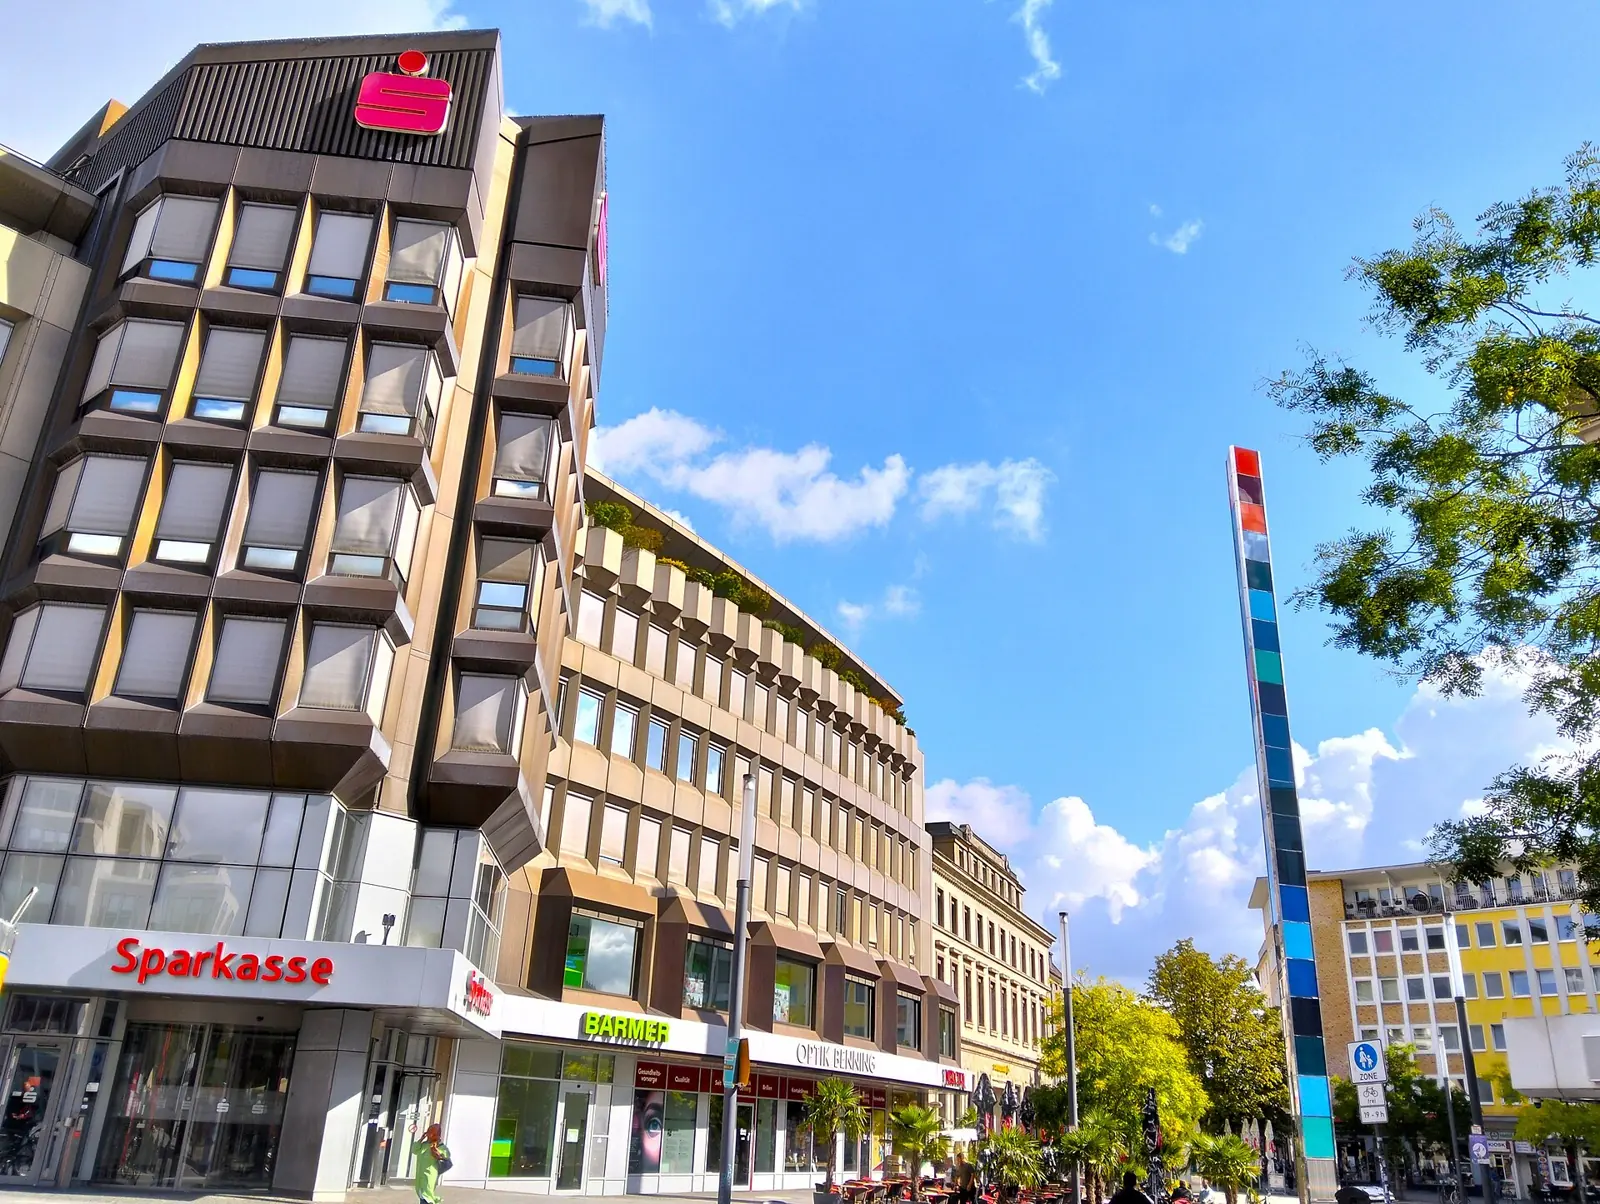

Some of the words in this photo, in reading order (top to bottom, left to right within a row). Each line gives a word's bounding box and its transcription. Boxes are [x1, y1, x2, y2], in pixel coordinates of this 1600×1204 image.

[111, 937, 334, 985] Sparkasse
[584, 1012, 670, 1043] BARMER
[796, 1043, 829, 1067] OPTIK
[833, 1047, 876, 1073] BENNING
[641, 1076, 658, 1084] vorsorge
[1360, 1073, 1377, 1081] ZONE
